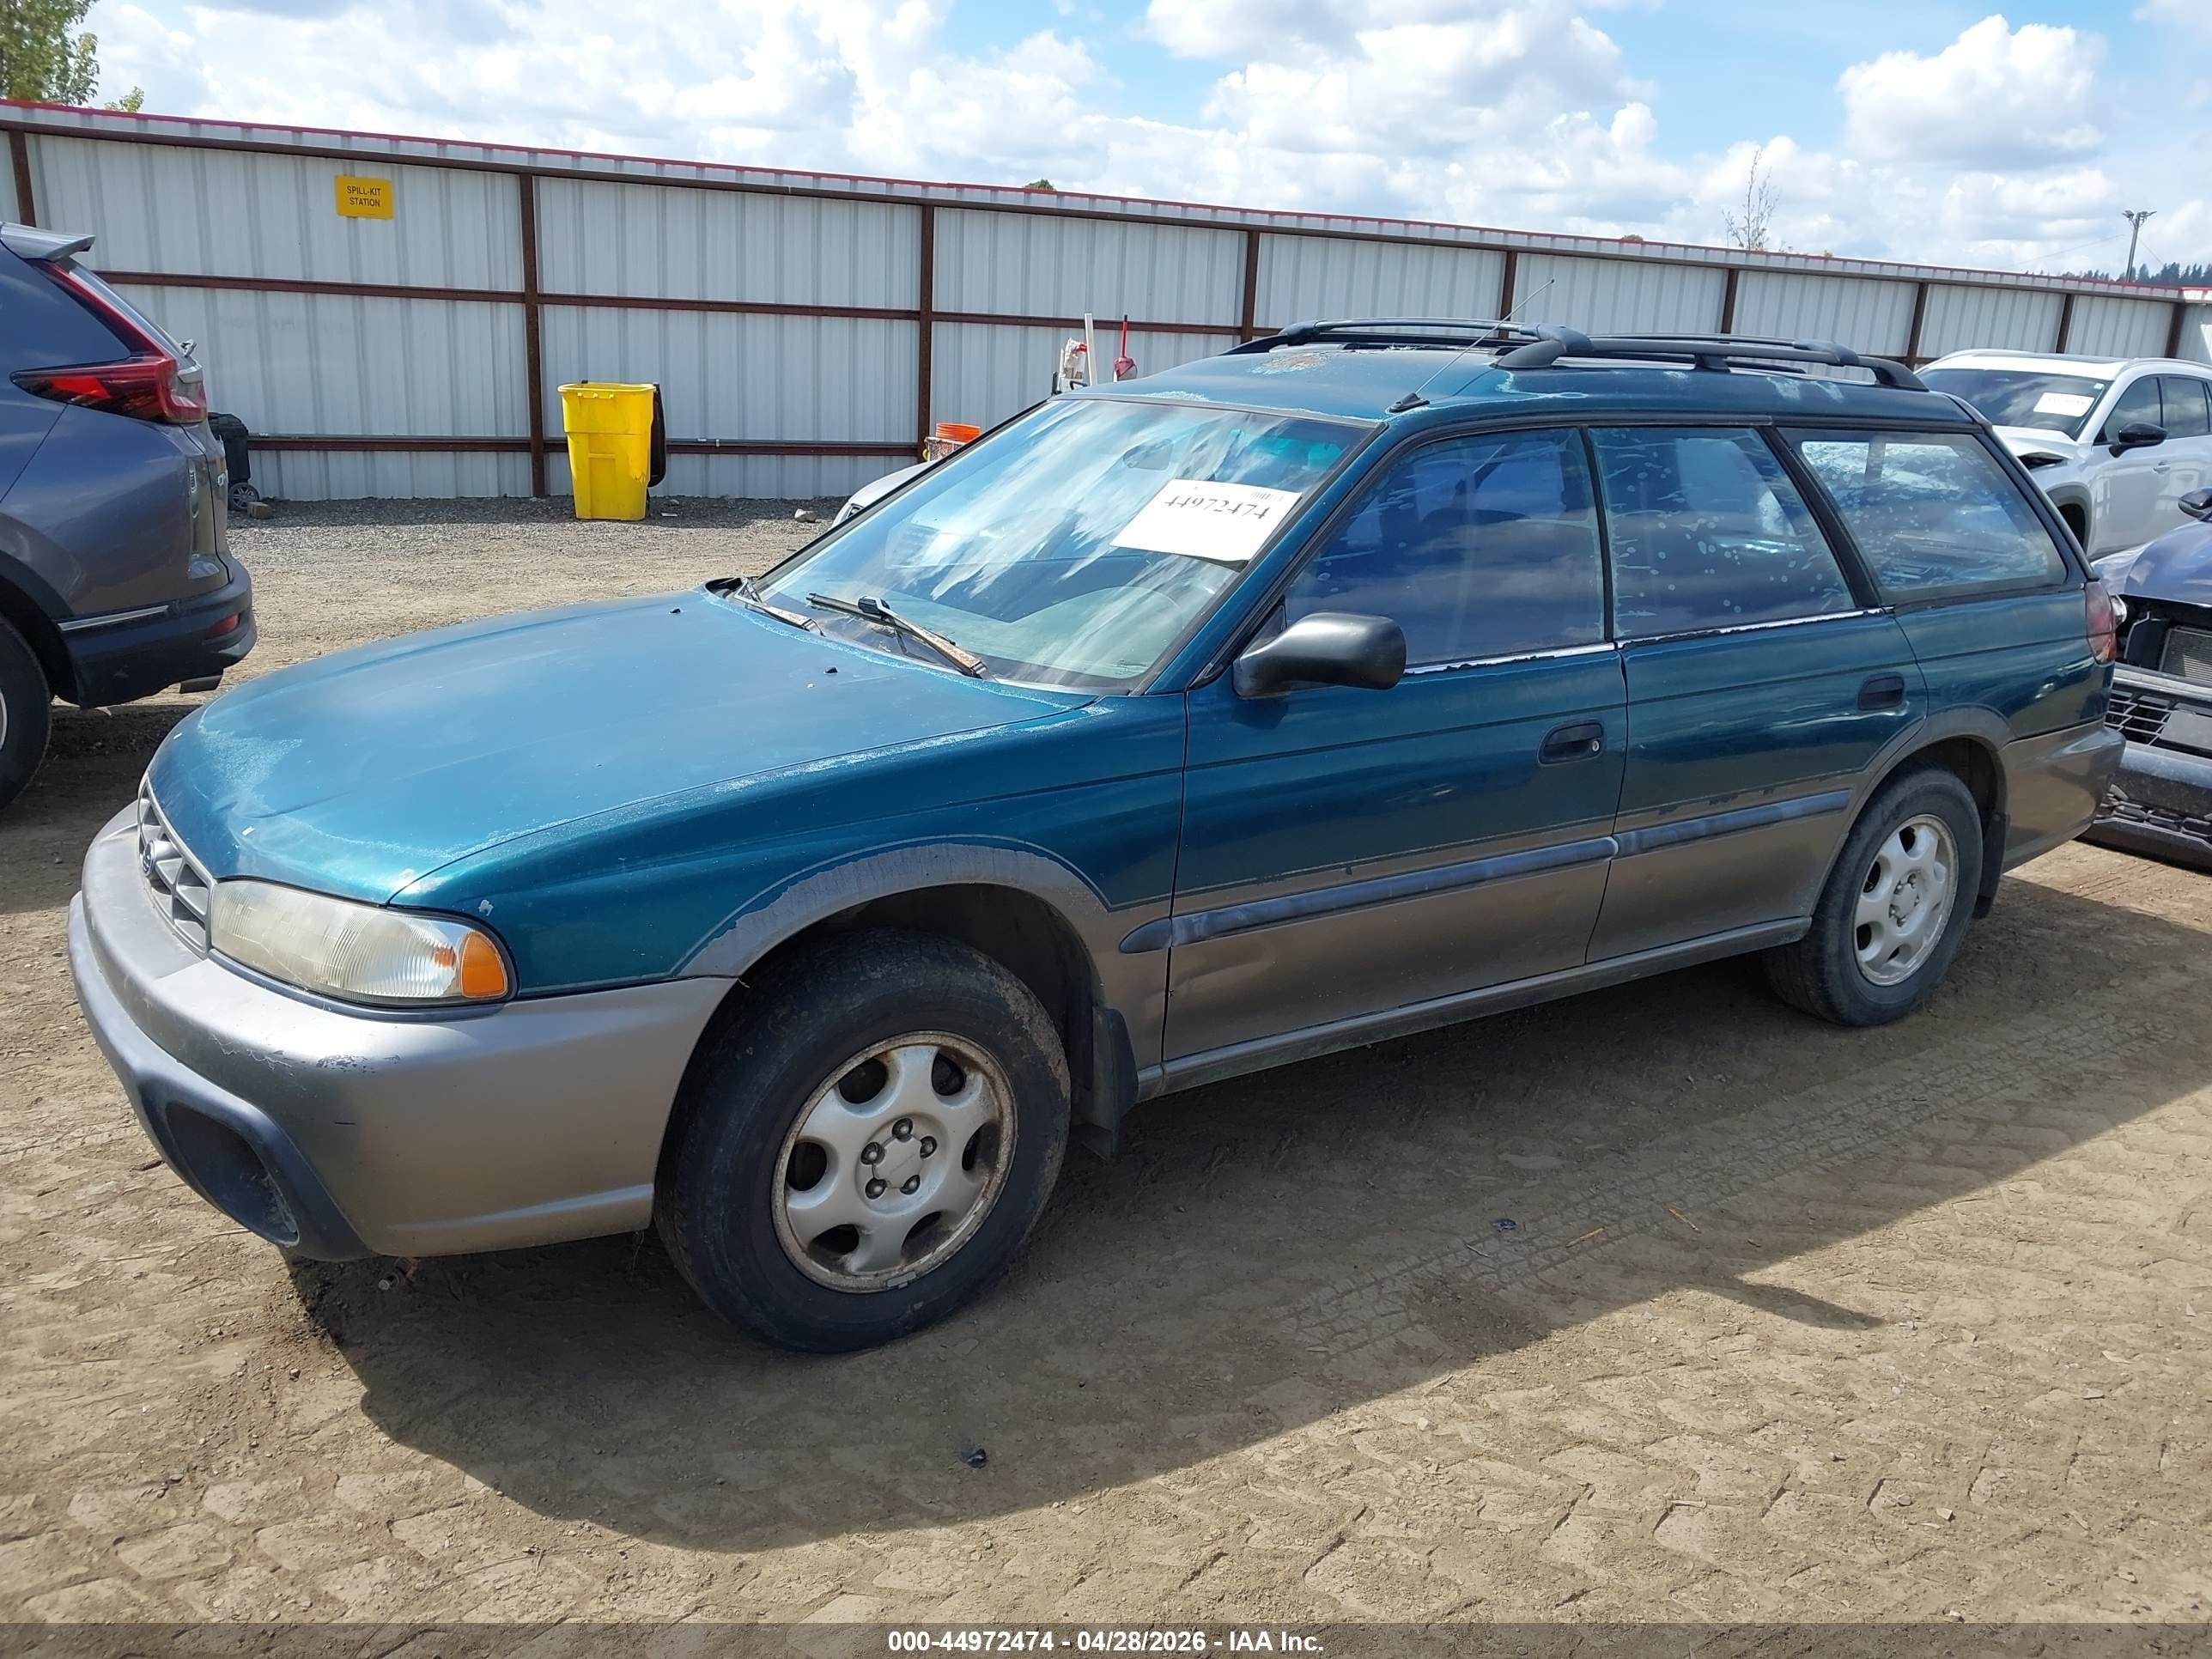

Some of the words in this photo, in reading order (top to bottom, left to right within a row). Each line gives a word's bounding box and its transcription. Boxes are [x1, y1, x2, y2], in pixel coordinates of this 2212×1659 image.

[346, 185, 380, 196] SPILL-KIT
[349, 197, 380, 207] STATION
[1164, 495, 1270, 519] 44972474
